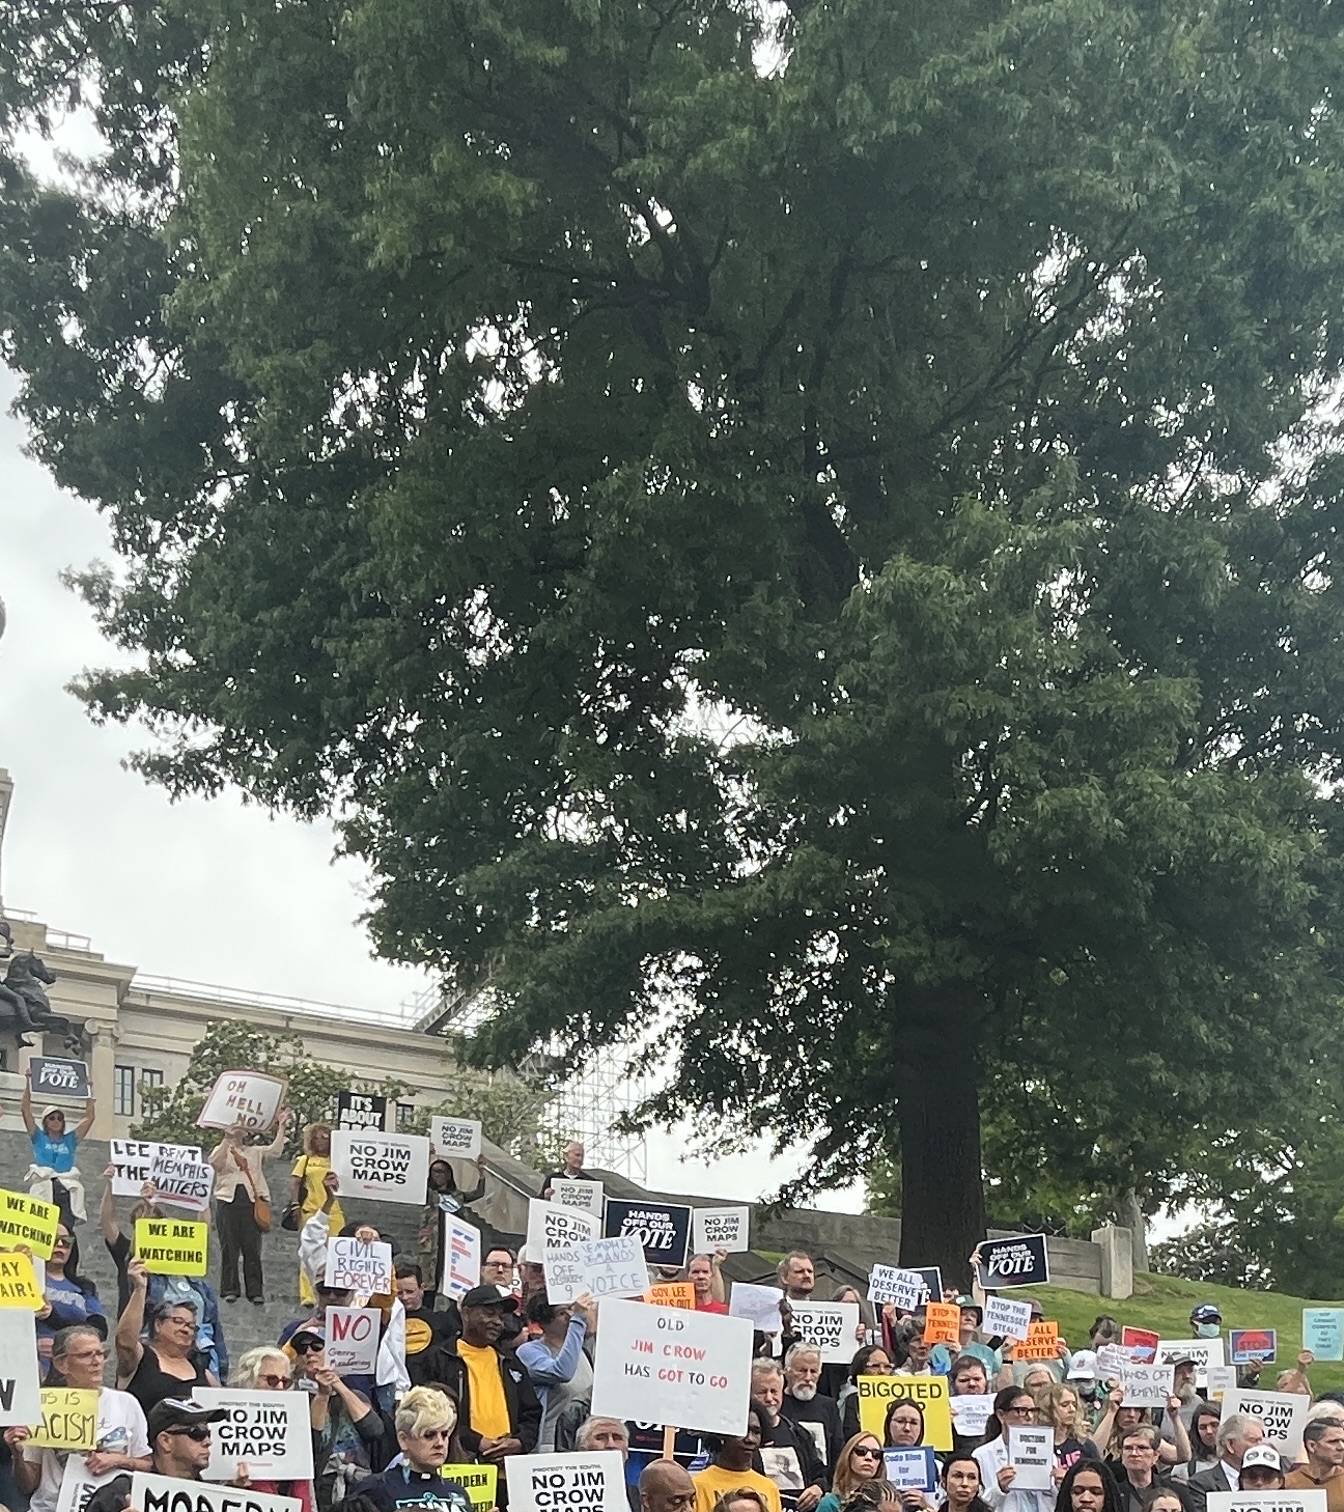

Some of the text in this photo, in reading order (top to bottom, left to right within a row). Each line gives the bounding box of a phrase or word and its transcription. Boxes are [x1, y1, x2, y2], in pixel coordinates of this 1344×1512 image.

[226, 1079, 247, 1093] OH
[225, 1094, 265, 1115] HELL
[349, 1095, 374, 1111] IT'S
[339, 1109, 382, 1125] ABOUT
[349, 1144, 411, 1161] NO JIM
[114, 1164, 149, 1182] THE
[153, 1157, 209, 1180] MEMPHIS
[349, 1157, 409, 1173] CROW
[351, 1169, 407, 1185] MAPS
[5, 1196, 50, 1220] WE ARE
[148, 1224, 195, 1238] WE ARE
[705, 1225, 739, 1233] CROW
[138, 1249, 203, 1264] WATCHING
[334, 1239, 380, 1259] CIVIL
[333, 1270, 390, 1291] FOREVER
[587, 1273, 644, 1293] VOICE
[879, 1269, 914, 1285] WE ALL
[651, 1287, 686, 1297] GOV. LEE
[871, 1279, 916, 1298] DESERVE
[874, 1292, 912, 1308] BETTER
[931, 1308, 950, 1317] STOP
[991, 1301, 1027, 1316] STOP THE
[657, 1317, 685, 1332] OLD
[987, 1311, 1028, 1327] TENNESSEE
[993, 1323, 1019, 1335] STEAL!
[1035, 1326, 1052, 1335] ALL
[1017, 1348, 1054, 1358] BETTER
[1239, 1340, 1269, 1350] STOP
[624, 1363, 728, 1389] HAS GOT TO GO
[859, 1382, 943, 1399] BIGOTED
[1124, 1385, 1170, 1399] MEMPHIS
[218, 1426, 287, 1441] CROW
[221, 1442, 287, 1456] MAPS
[532, 1471, 605, 1490] NO JIM
[535, 1488, 605, 1506] CROW
